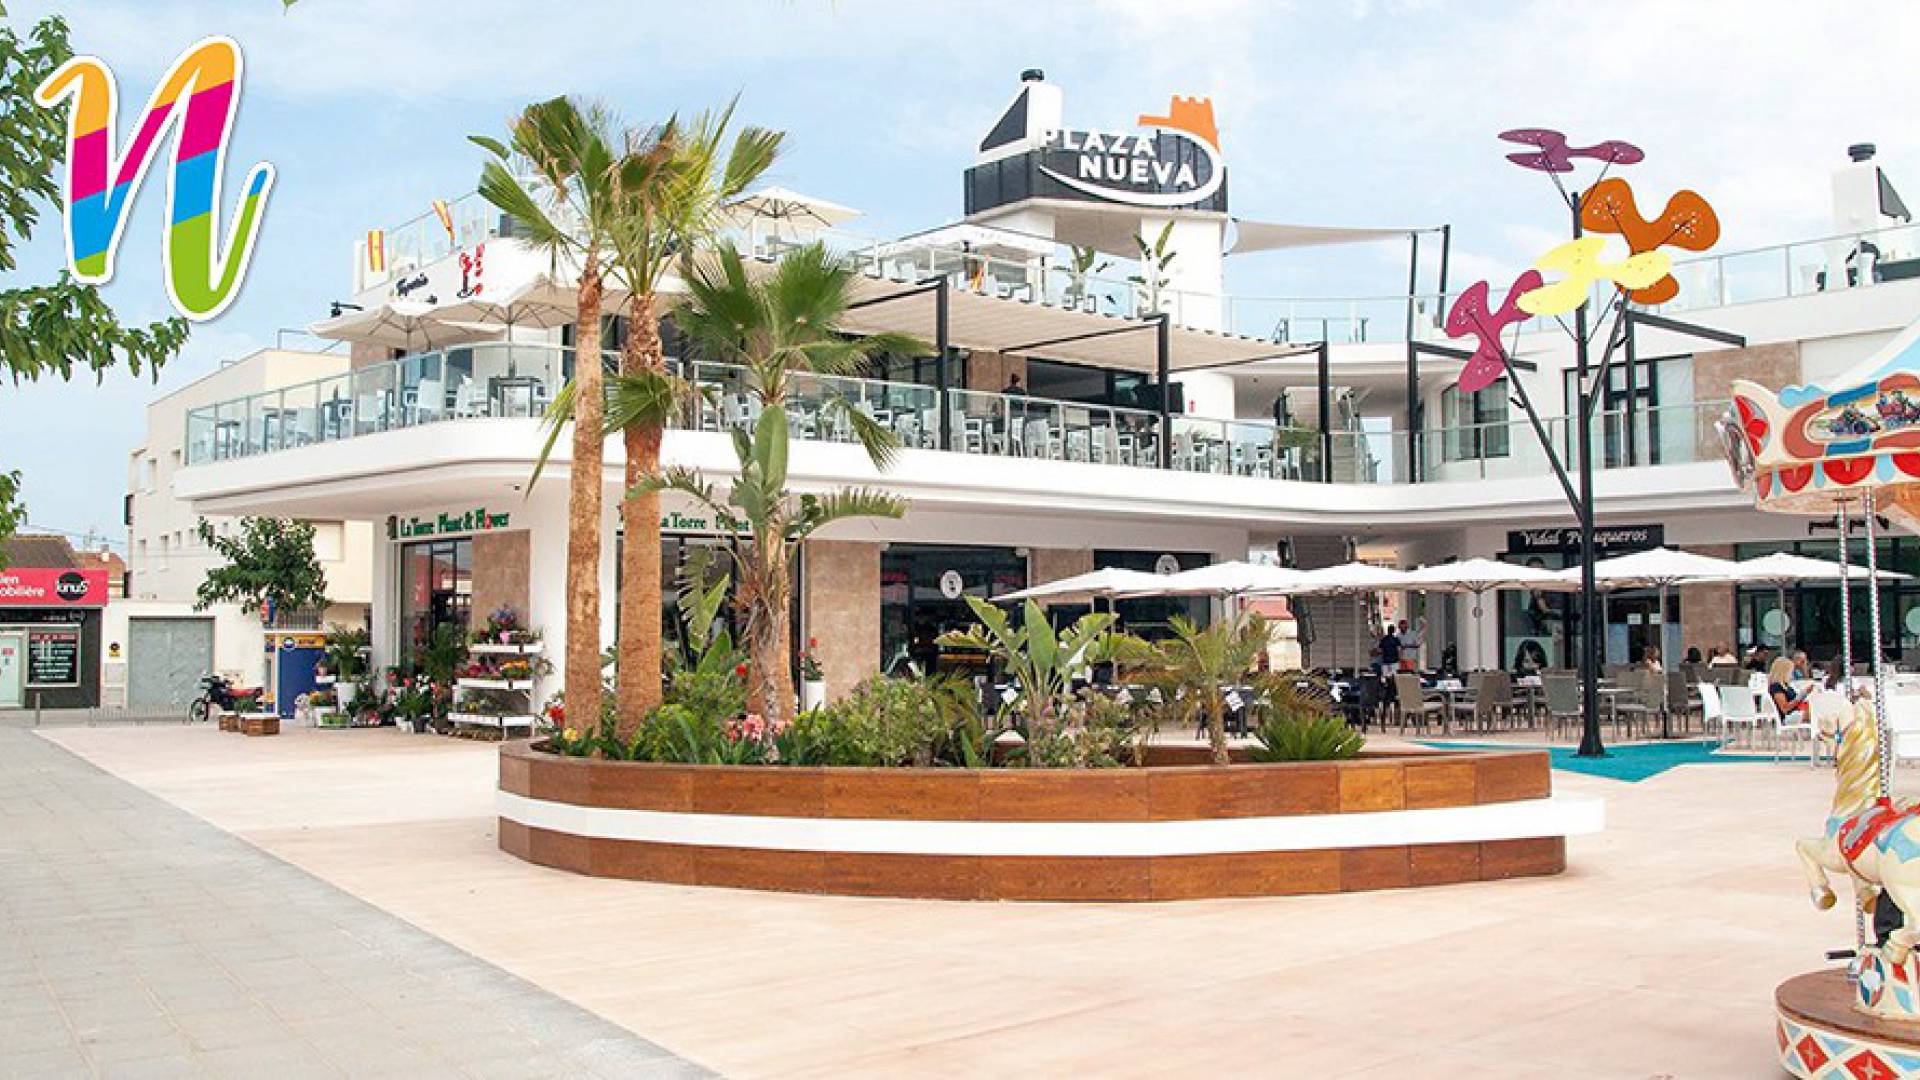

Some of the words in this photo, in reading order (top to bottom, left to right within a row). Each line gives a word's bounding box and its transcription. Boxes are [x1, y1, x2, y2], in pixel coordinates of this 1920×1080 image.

[1040, 129, 1156, 157] PLAZA
[1080, 155, 1196, 188] NUEVA
[1522, 529, 1564, 545] Vidal
